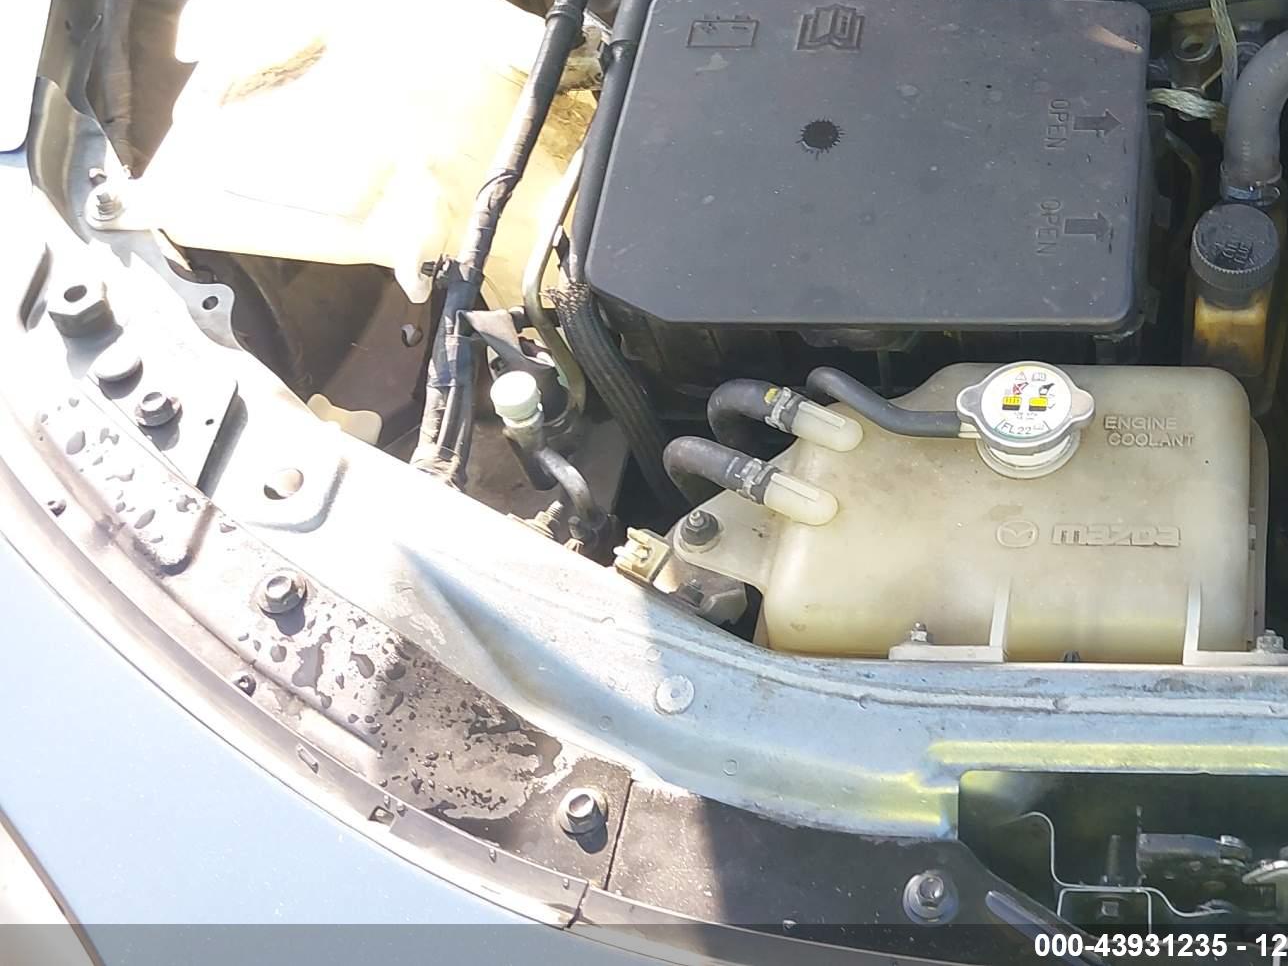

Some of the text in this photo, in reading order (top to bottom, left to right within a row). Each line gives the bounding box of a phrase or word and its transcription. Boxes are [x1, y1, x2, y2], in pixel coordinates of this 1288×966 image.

[1045, 98, 1071, 150] OPEN
[1036, 198, 1062, 255] OPEN
[1104, 416, 1177, 431] ENGINE
[1108, 432, 1194, 448] COOLANT
